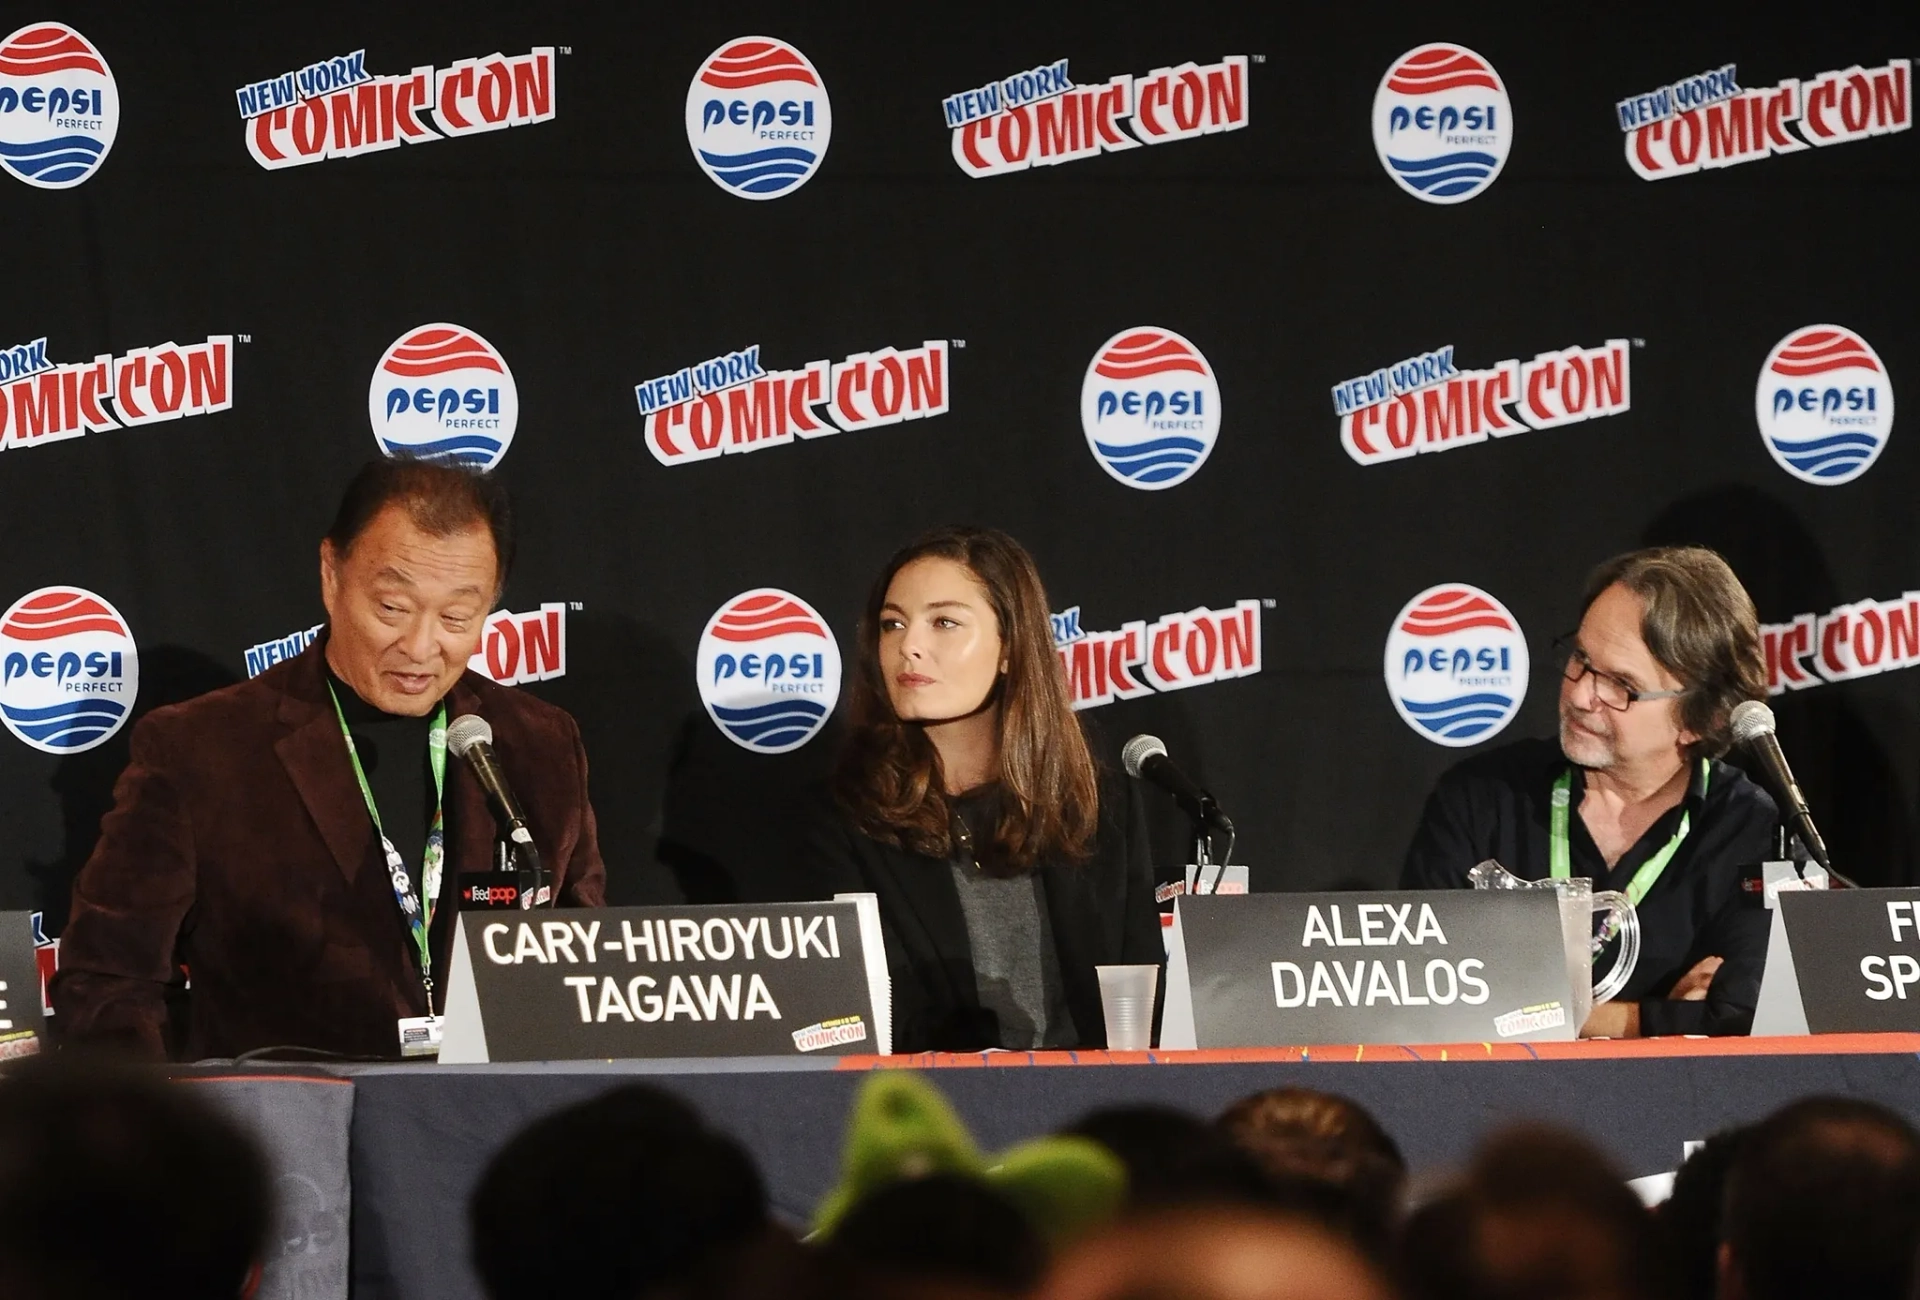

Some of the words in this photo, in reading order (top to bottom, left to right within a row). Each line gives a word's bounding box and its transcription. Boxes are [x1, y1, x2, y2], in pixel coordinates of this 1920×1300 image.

[240, 75, 294, 114] NEW
[300, 53, 366, 96] YORK
[255, 75, 428, 160] COMIC
[441, 56, 549, 128] CON
[946, 85, 998, 123] NEW
[1005, 65, 1070, 106] YORK
[1622, 88, 1671, 124] NEW
[1677, 71, 1737, 107] YORK
[56, 118, 103, 131] PERFECT
[760, 130, 815, 141] PERFECT
[962, 85, 1125, 168] COMIC
[1140, 65, 1241, 136] CON
[1446, 133, 1498, 145] PERFECT
[1636, 89, 1792, 170] COMIC
[1808, 67, 1905, 137] CON
[0, 341, 50, 381] ORK
[638, 370, 691, 411] NEW
[696, 350, 760, 391] YORK
[1336, 373, 1388, 411] NEW
[1393, 351, 1454, 390] YORK
[0, 363, 108, 439] MIC
[119, 344, 227, 418] CON
[654, 371, 821, 455] COMIC
[837, 349, 943, 421] CON
[1351, 370, 1511, 454] COMIC
[1527, 350, 1623, 420] CON
[445, 417, 500, 429] PERFECT
[1152, 420, 1205, 430] PERFECT
[247, 635, 301, 676] NEW
[474, 612, 560, 681] ON
[1153, 609, 1255, 682] CON
[1823, 602, 1920, 673] CON
[65, 681, 123, 693] PERFECT
[772, 683, 824, 694] PERFECT
[483, 916, 840, 965] CARY-HIROYUKI
[1302, 903, 1448, 947] ALEXA
[564, 974, 782, 1023] TAGAWA
[1271, 959, 1490, 1008] DAVALOS
[799, 1030, 836, 1049] COMIC
[840, 1025, 864, 1041] CON
